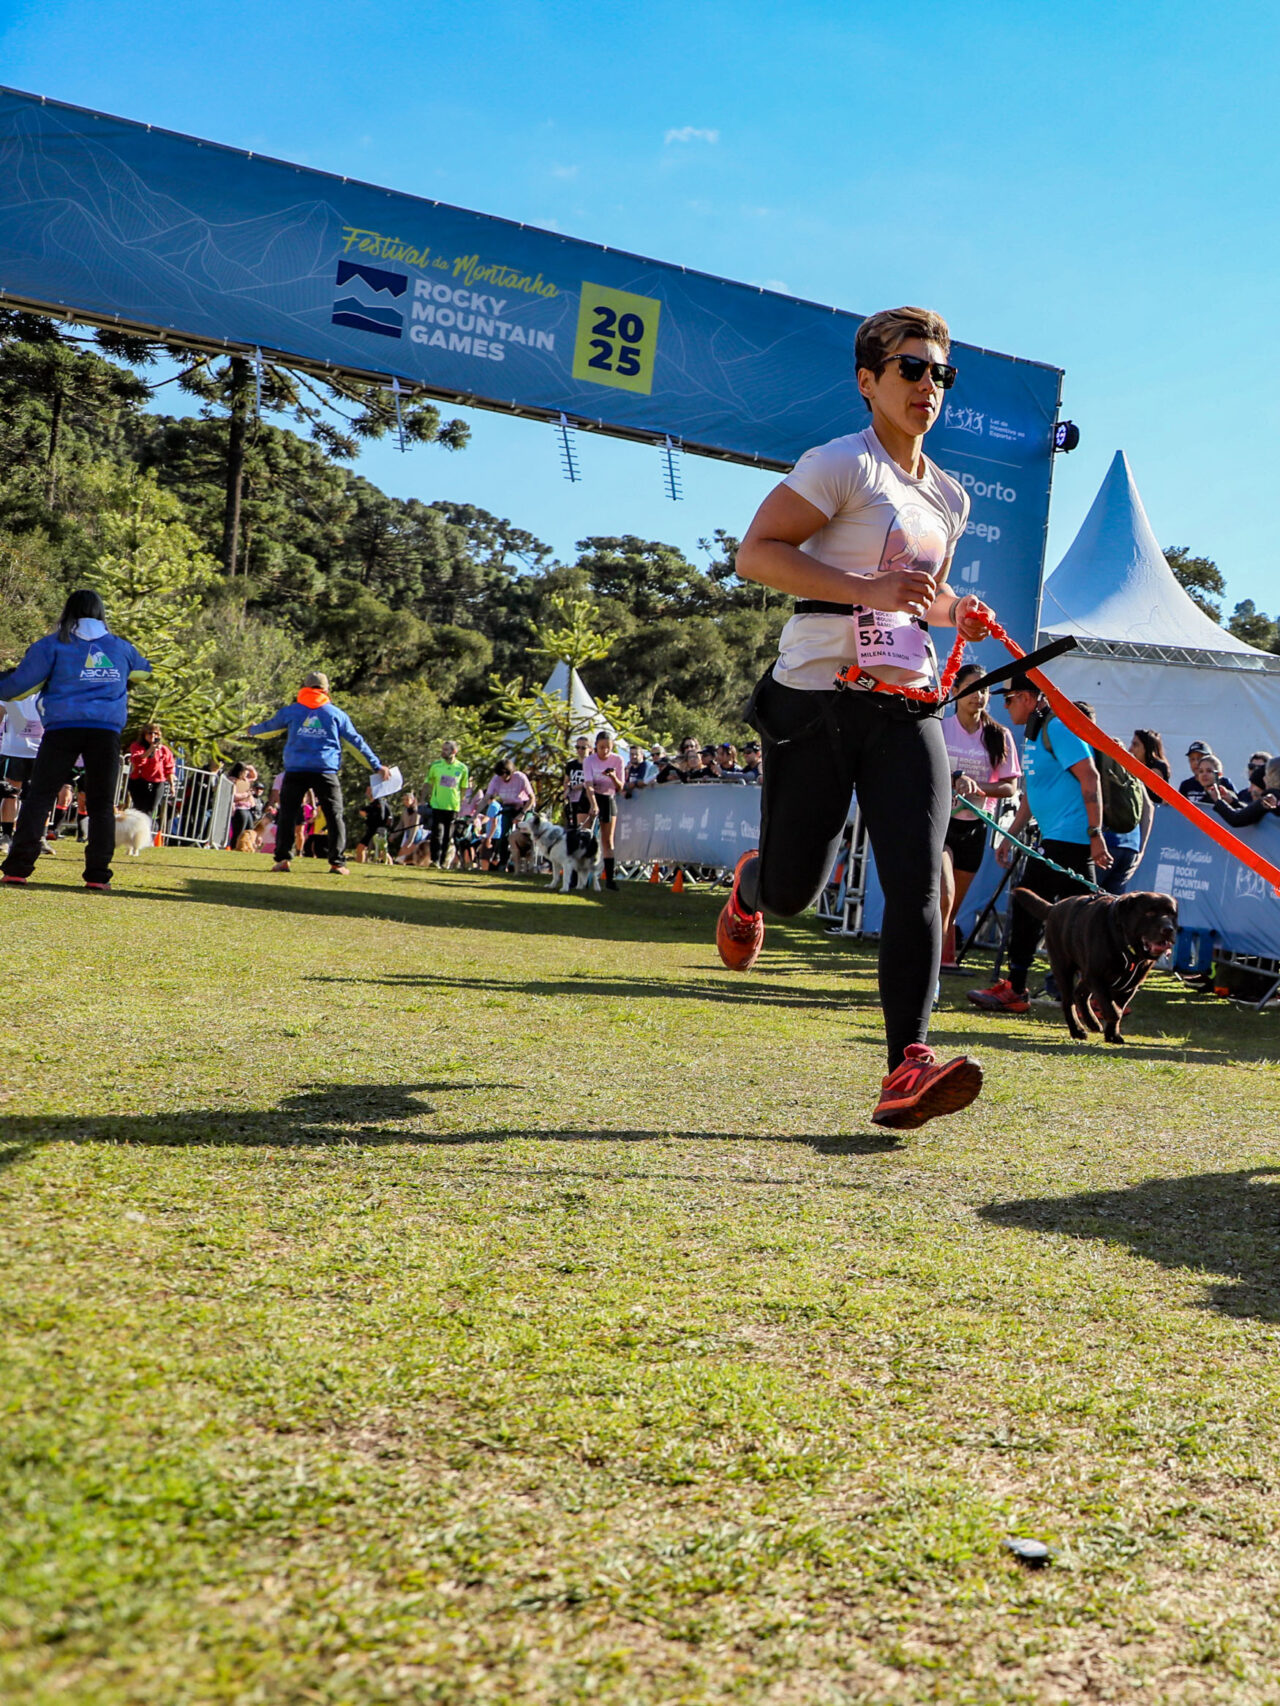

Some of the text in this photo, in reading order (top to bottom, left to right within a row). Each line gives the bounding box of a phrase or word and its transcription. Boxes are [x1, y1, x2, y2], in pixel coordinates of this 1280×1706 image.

[342, 226, 560, 298] Festival da Montanha
[414, 279, 507, 316] ROCKY
[411, 301, 555, 351] MOUNTAIN
[592, 306, 645, 343] 20
[410, 325, 505, 361] GAMES
[588, 338, 641, 376] 25
[961, 472, 1016, 503] Porto
[965, 520, 1000, 542] eep
[859, 629, 895, 647] 523
[1174, 878, 1210, 891] MOUNTAIN
[1175, 867, 1199, 877] ROCKY
[1172, 889, 1196, 900] GAMES
